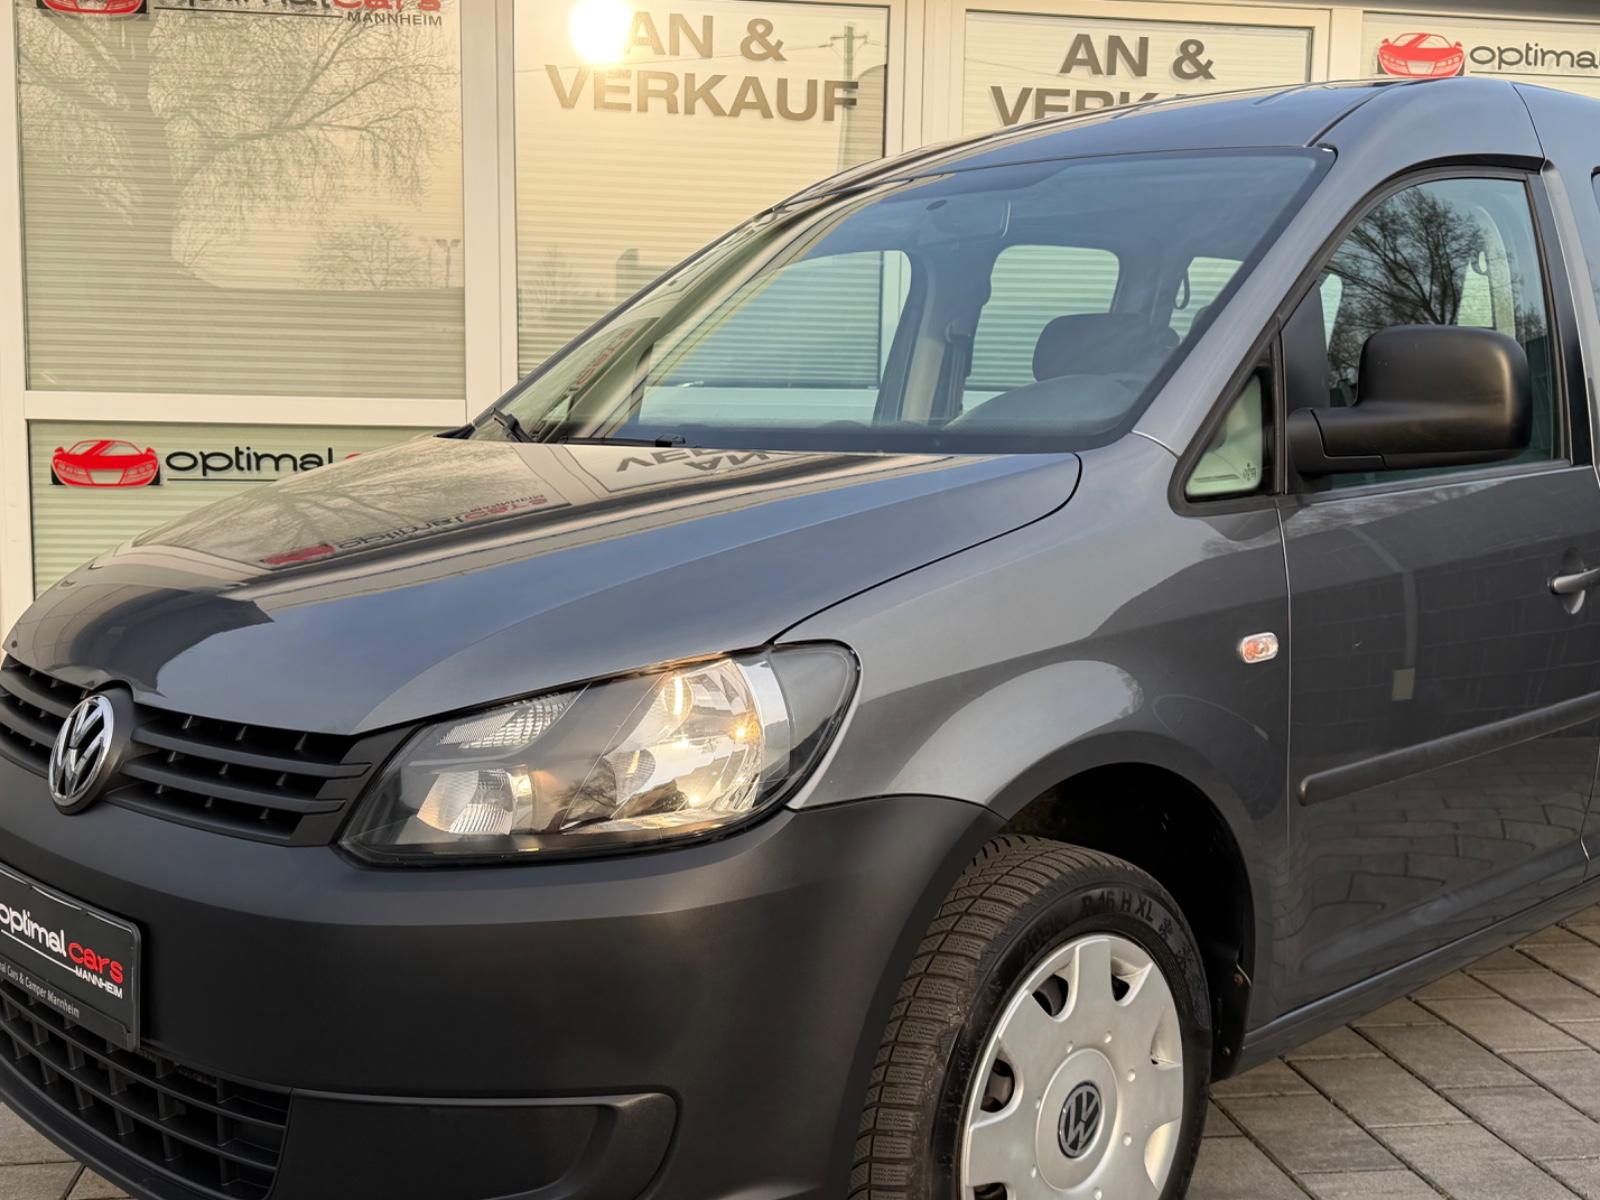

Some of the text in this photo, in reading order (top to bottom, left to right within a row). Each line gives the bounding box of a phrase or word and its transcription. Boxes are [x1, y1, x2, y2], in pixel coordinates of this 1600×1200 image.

[346, 11, 442, 26] MANNHEIM
[625, 11, 787, 62] AN &
[1059, 33, 1216, 80] AN &
[1469, 42, 1600, 70] optima
[545, 64, 859, 121] VERKAUF
[166, 446, 363, 477] optimal
[1134, 895, 1154, 922] XL
[25, 976, 47, 998] Camper
[47, 990, 80, 1018] Mannheim
[75, 965, 124, 999] MANNHEIM
